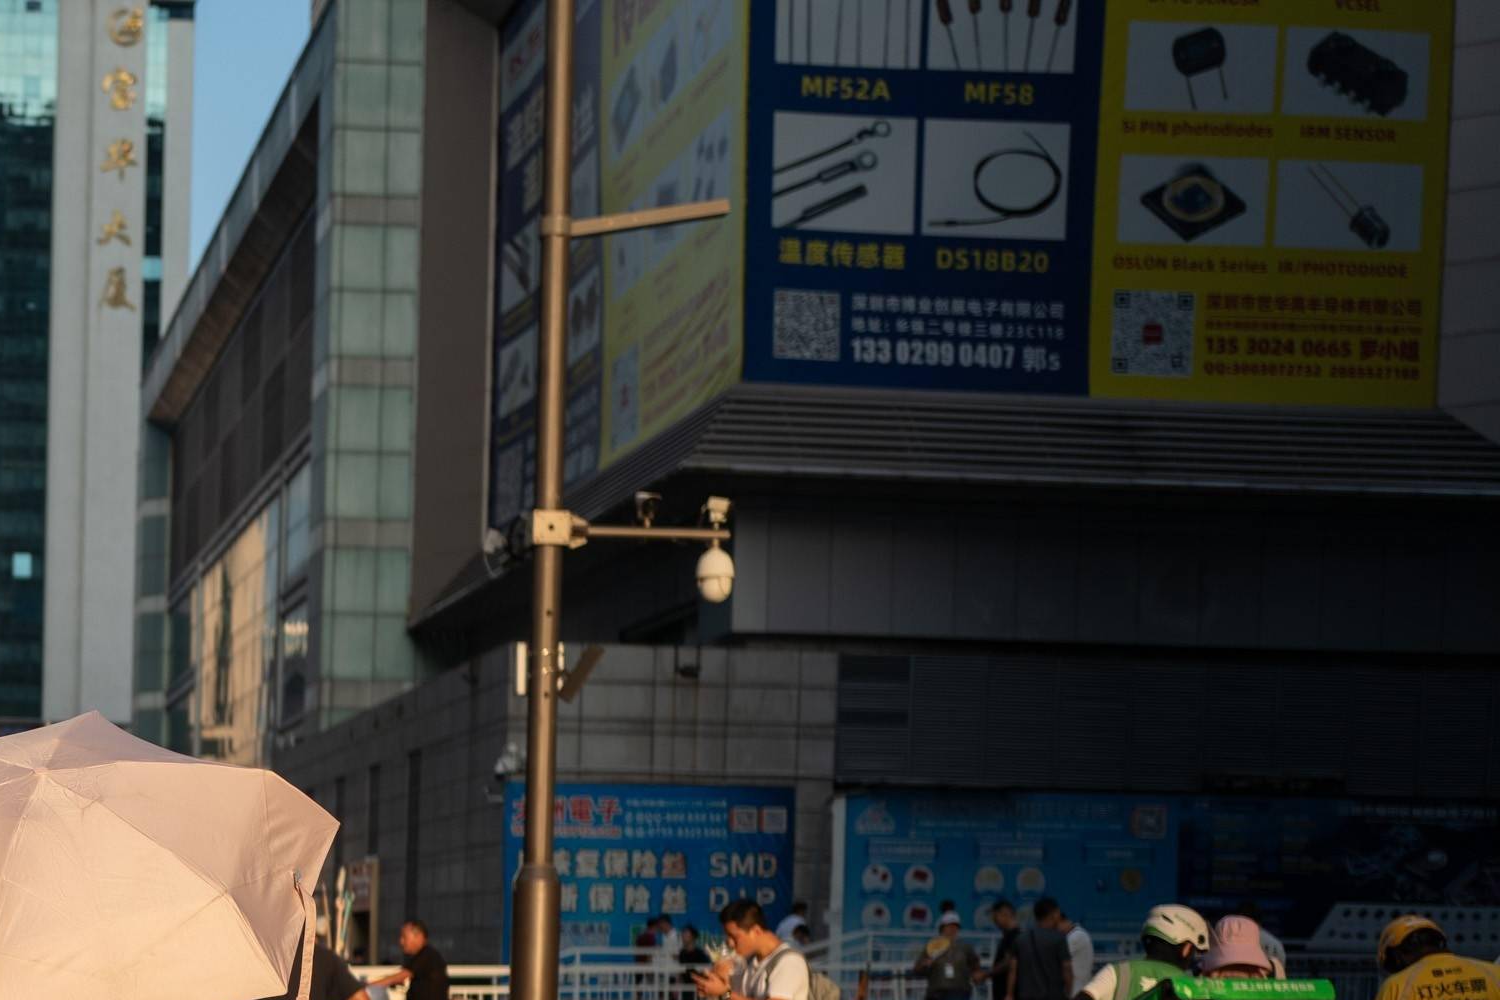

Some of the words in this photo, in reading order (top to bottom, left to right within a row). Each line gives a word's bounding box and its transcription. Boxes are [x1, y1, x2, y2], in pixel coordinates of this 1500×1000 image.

[800, 75, 891, 102] MF52A
[964, 81, 1035, 106] MF58
[1139, 120, 1167, 136] PIN
[1171, 122, 1274, 140] photodiodes
[1334, 126, 1396, 143] SENSOR
[779, 237, 907, 271] 温度传感器
[936, 246, 1050, 273] DS18B20
[1113, 255, 1167, 272] OSLON
[1171, 256, 1215, 273] Black
[1220, 258, 1269, 275] Series
[851, 338, 892, 365] 133
[896, 339, 954, 367] 0299
[958, 341, 1014, 369] 0407
[1205, 337, 1238, 355] 135
[1246, 337, 1295, 356] 3024
[1301, 338, 1351, 358] 0665
[709, 851, 778, 880] SMD
